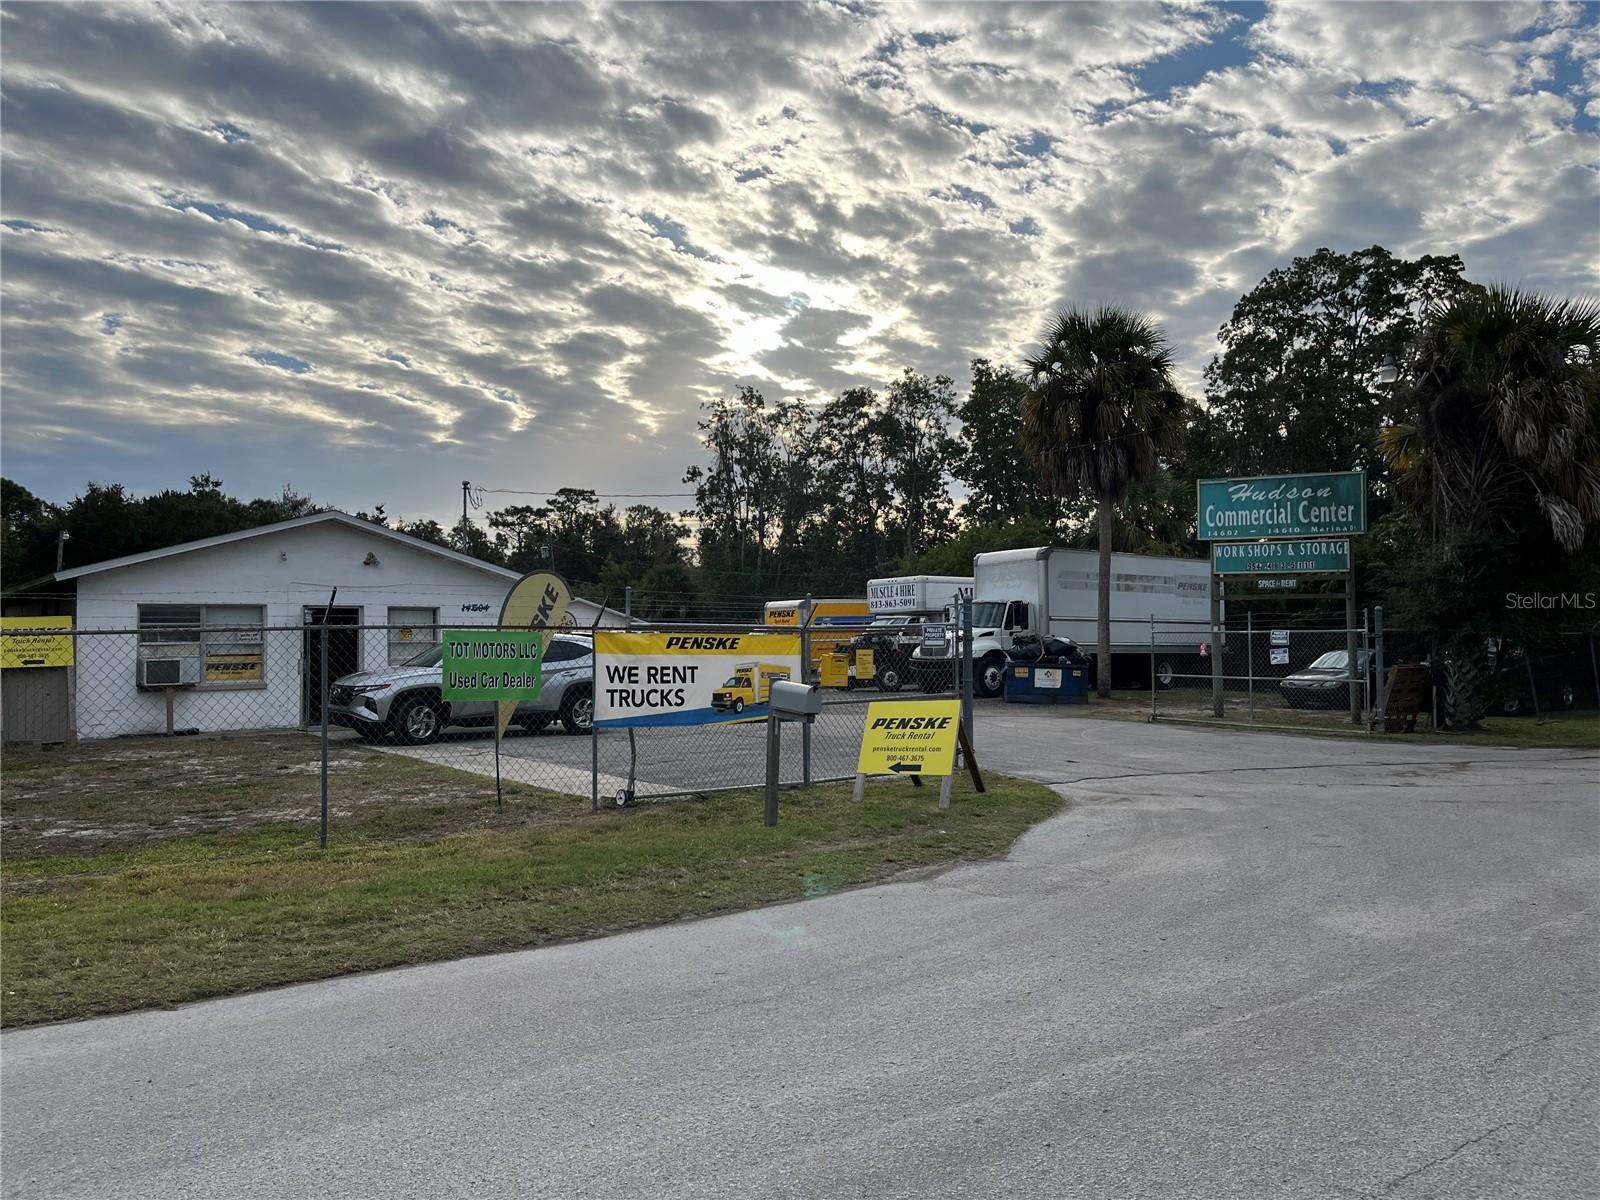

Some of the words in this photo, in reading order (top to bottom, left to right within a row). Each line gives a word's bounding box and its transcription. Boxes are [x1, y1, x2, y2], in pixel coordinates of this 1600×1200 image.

[1228, 483, 1332, 502] Hudson
[1205, 502, 1291, 527] Commercial
[1299, 501, 1355, 524] Center
[1268, 527, 1300, 535] 14610
[1288, 543, 1296, 556] &
[1300, 541, 1349, 556] STORAGE
[1257, 579, 1276, 588] SPACE
[1280, 579, 1297, 588] RENT
[870, 585, 894, 599] MUSCLE
[900, 584, 915, 597] HIRE
[870, 598, 915, 609] 813-863-5091
[769, 609, 796, 618] PENSKE
[449, 642, 470, 658] TOT
[473, 642, 516, 658] MOTORS
[519, 643, 537, 658] LLC
[666, 637, 741, 650] PENSKE
[206, 663, 258, 671] PENSKE
[449, 672, 477, 688] Used
[480, 672, 499, 688] Car
[503, 672, 536, 688] Dealer
[606, 665, 639, 684] WE
[647, 666, 698, 684] RENT
[606, 689, 685, 708] TRUCKS
[870, 716, 952, 730] PENSKE
[884, 731, 906, 740] Truck
[907, 731, 936, 740] Rental
[872, 745, 942, 753] pensketruckrental.com
[886, 754, 925, 762] 800-467-3675
